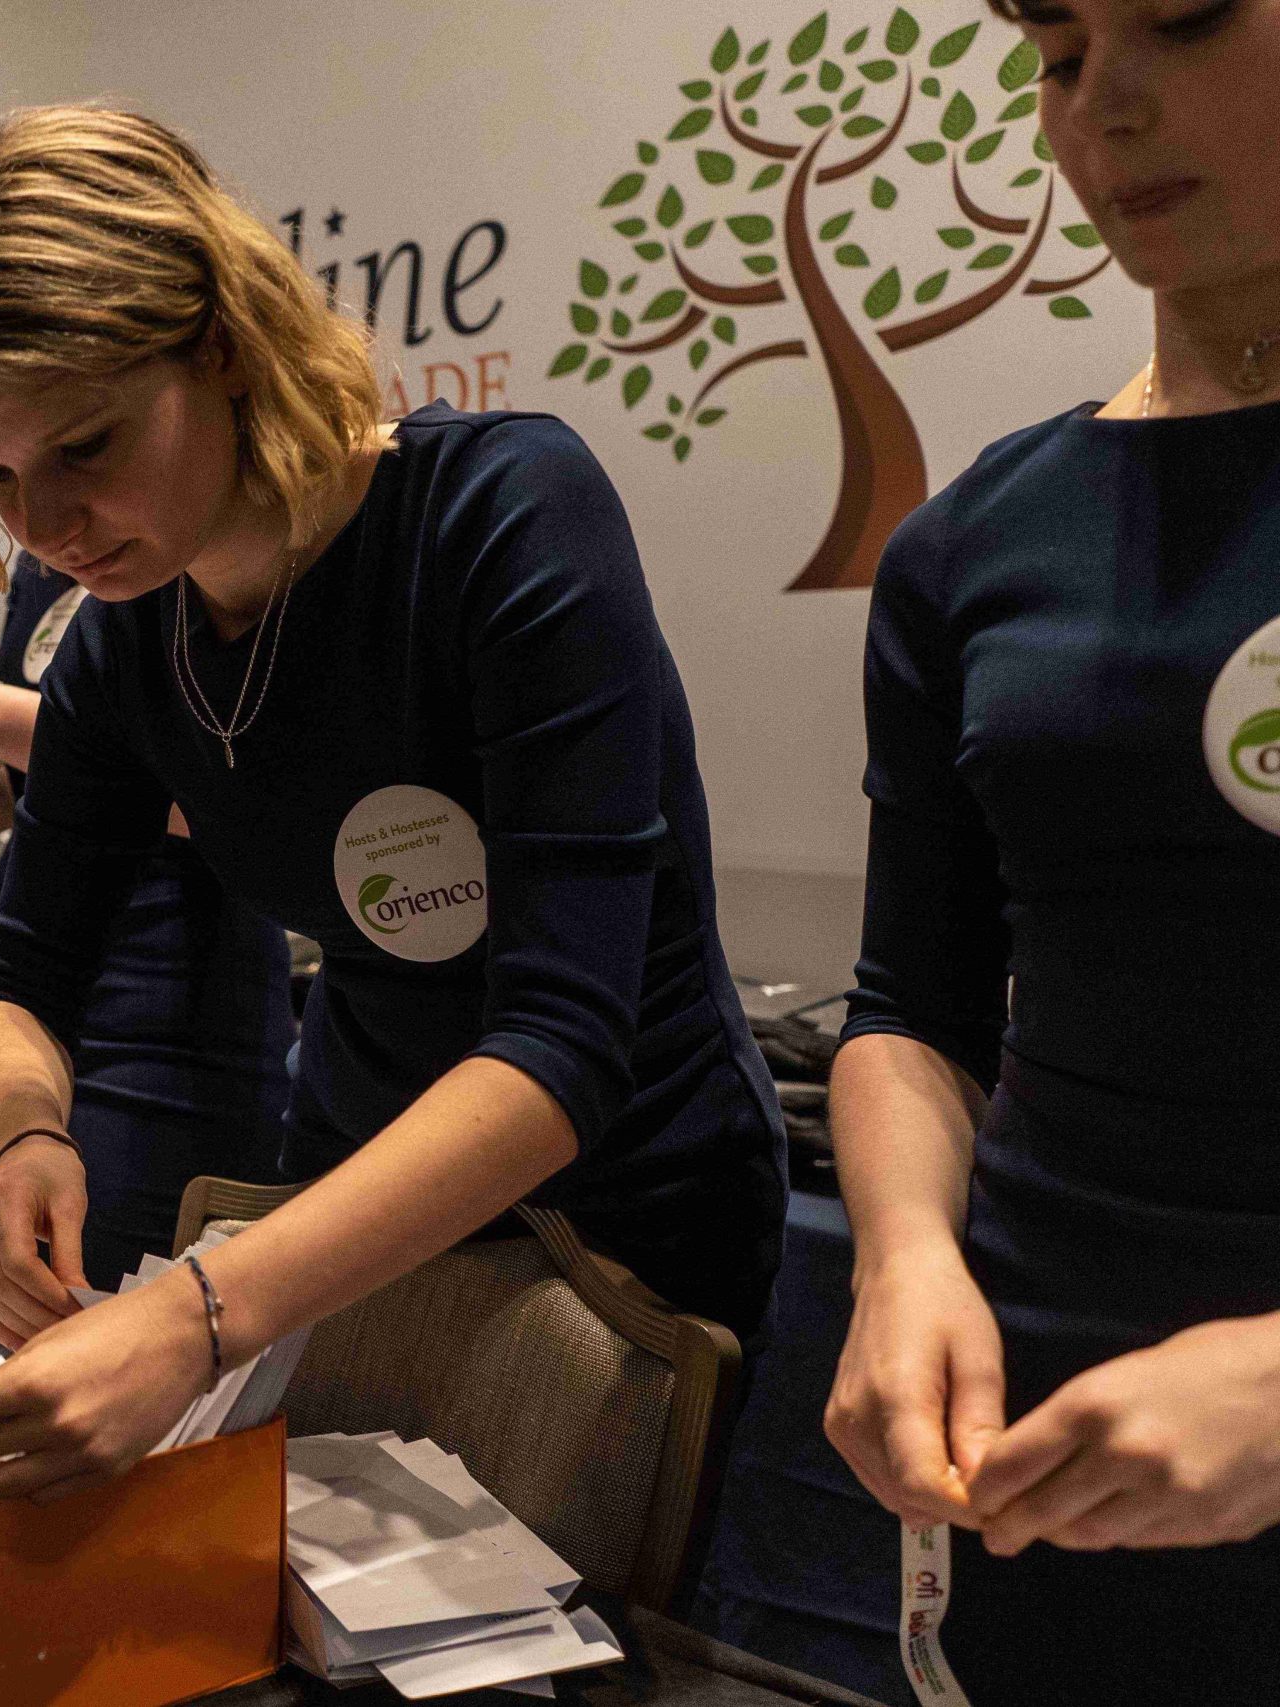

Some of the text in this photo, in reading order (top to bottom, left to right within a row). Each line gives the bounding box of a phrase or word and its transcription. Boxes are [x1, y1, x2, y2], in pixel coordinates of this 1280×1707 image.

[344, 813, 450, 849] Hosts & Hostesses
[365, 832, 441, 862] sponsored by
[376, 880, 485, 922] orienco
